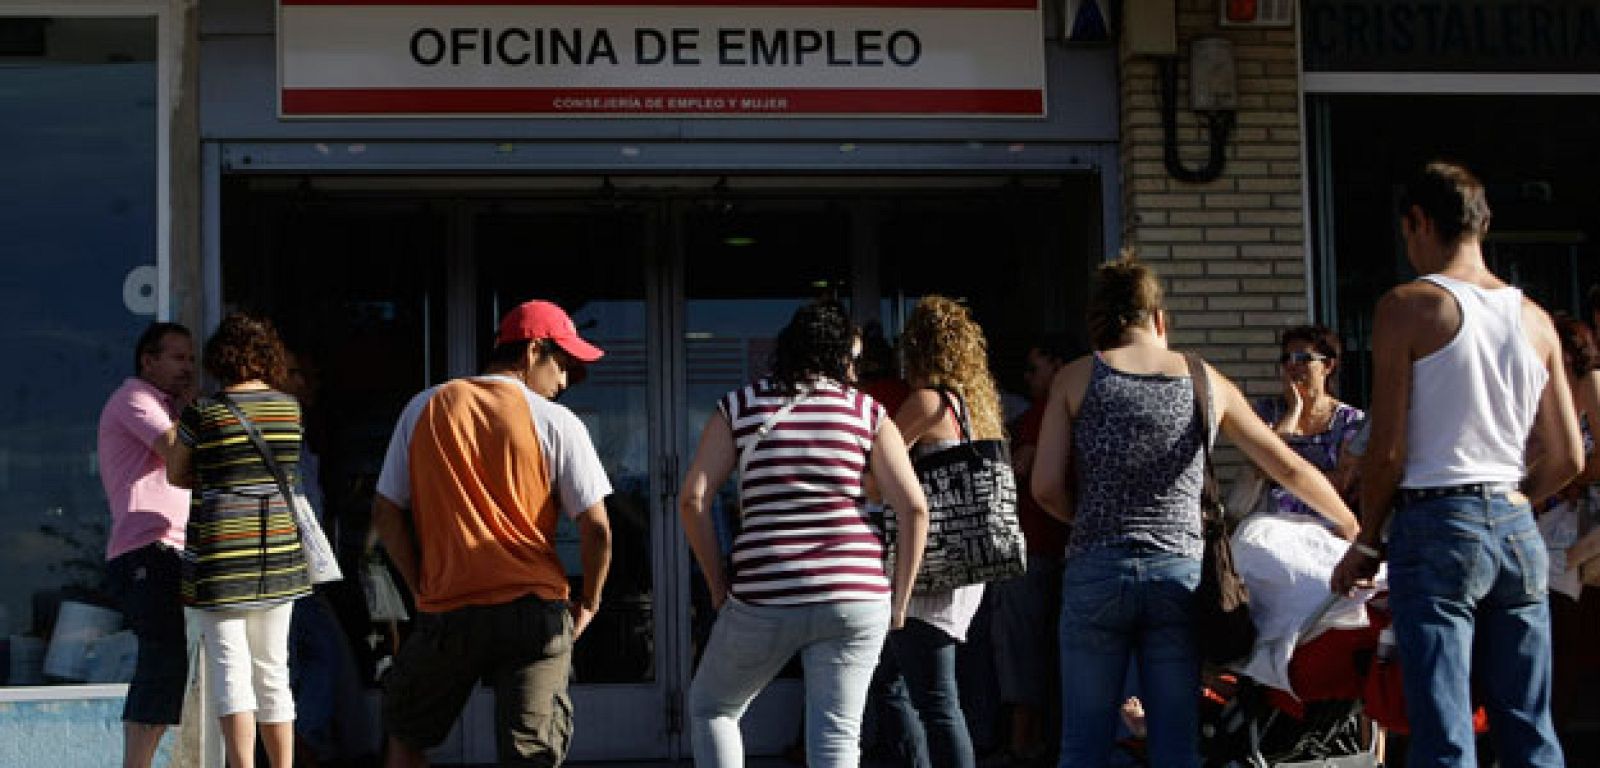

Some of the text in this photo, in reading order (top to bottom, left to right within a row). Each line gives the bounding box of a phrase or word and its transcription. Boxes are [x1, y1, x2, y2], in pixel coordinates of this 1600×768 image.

[408, 27, 923, 68] OFICINA DE EMPLEO
[644, 96, 663, 109] DE
[667, 97, 724, 109] EMPLEO
[741, 97, 787, 109] MUJER
